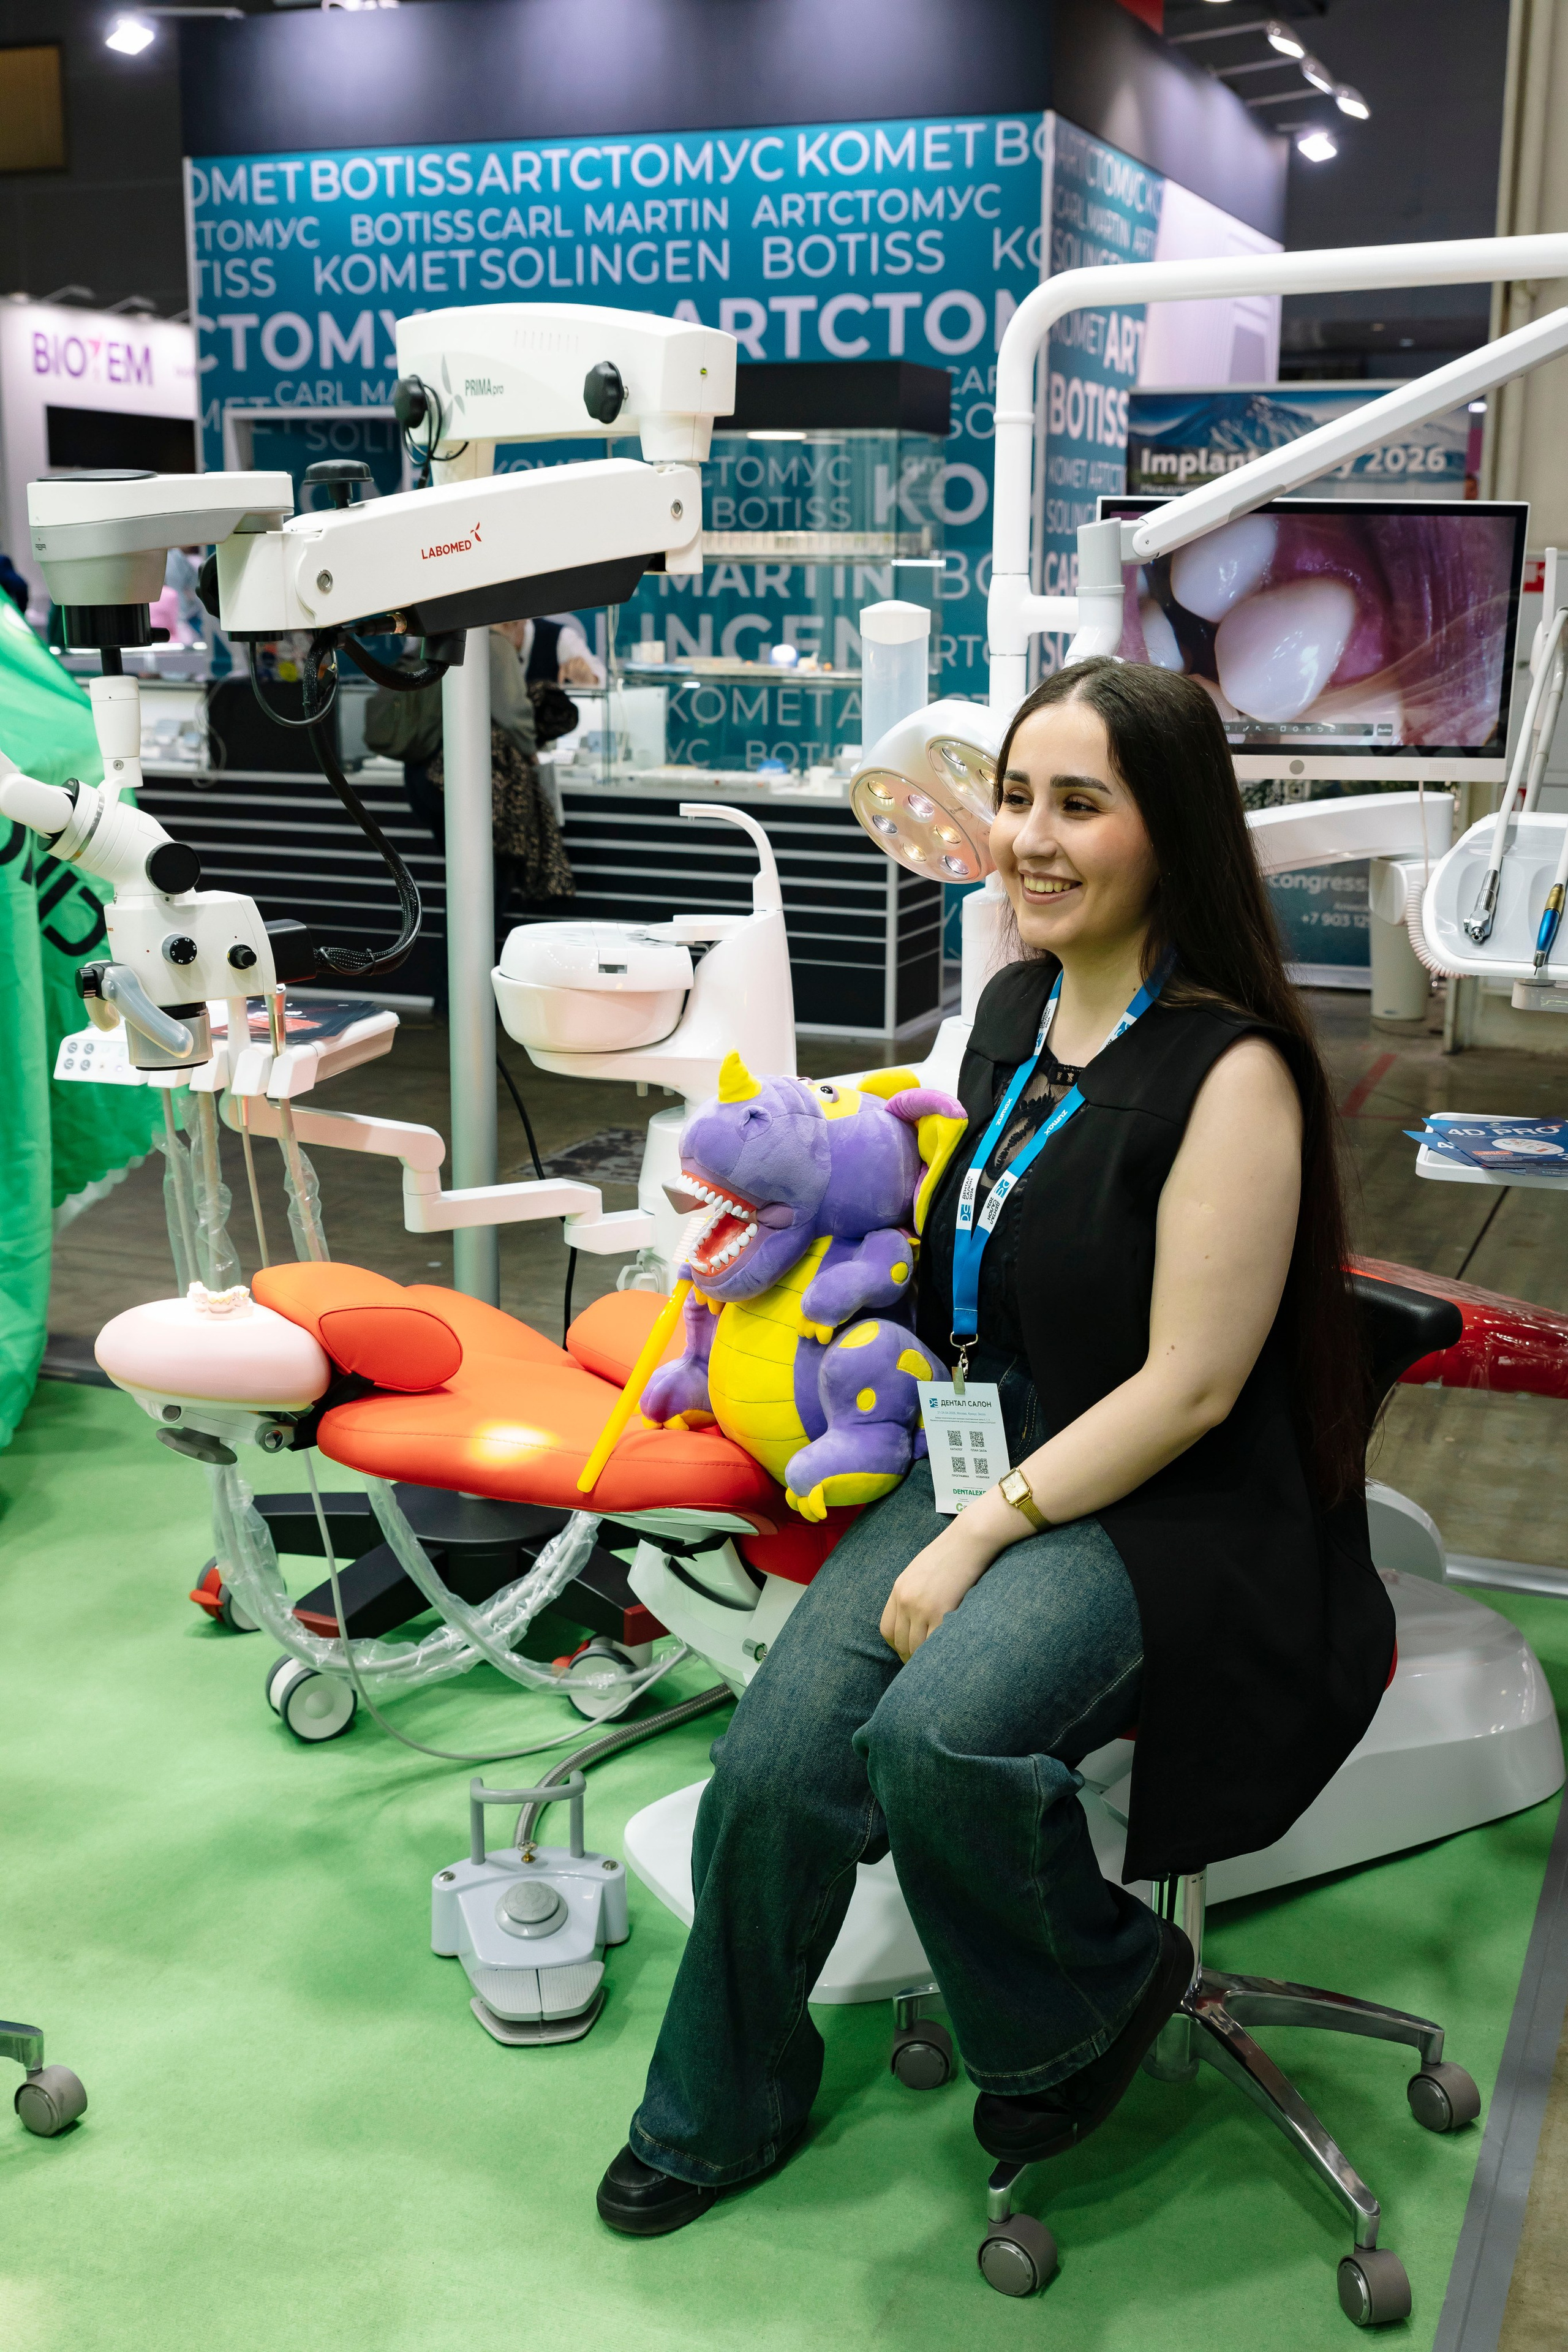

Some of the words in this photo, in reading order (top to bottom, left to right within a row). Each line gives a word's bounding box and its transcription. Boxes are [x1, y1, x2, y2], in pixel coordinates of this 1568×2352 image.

[311, 151, 473, 203] BOTISS
[798, 123, 986, 178] KOMET
[350, 209, 477, 247] BOTISS
[478, 204, 574, 241] CARL
[584, 197, 729, 236] MARTIN
[313, 249, 476, 296] KOMET
[480, 239, 730, 291] SOLINGEN
[763, 229, 945, 280] BOTISS
[275, 379, 352, 407] CARL
[1049, 371, 1129, 448] BOTISS
[1365, 443, 1447, 473] 2026
[711, 496, 853, 530] BOTISS
[421, 539, 472, 560] LABOMED
[995, 1098, 1013, 1126] zumax
[1044, 1109, 1068, 1136] zumax
[1447, 1128, 1487, 1137] 4D
[1494, 1126, 1560, 1137] PRO
[962, 1176, 971, 1200] ДЕНТАЛ
[987, 1199, 998, 1221] САЛОН
[990, 1200, 1000, 1225] ДЕНТАЛ
